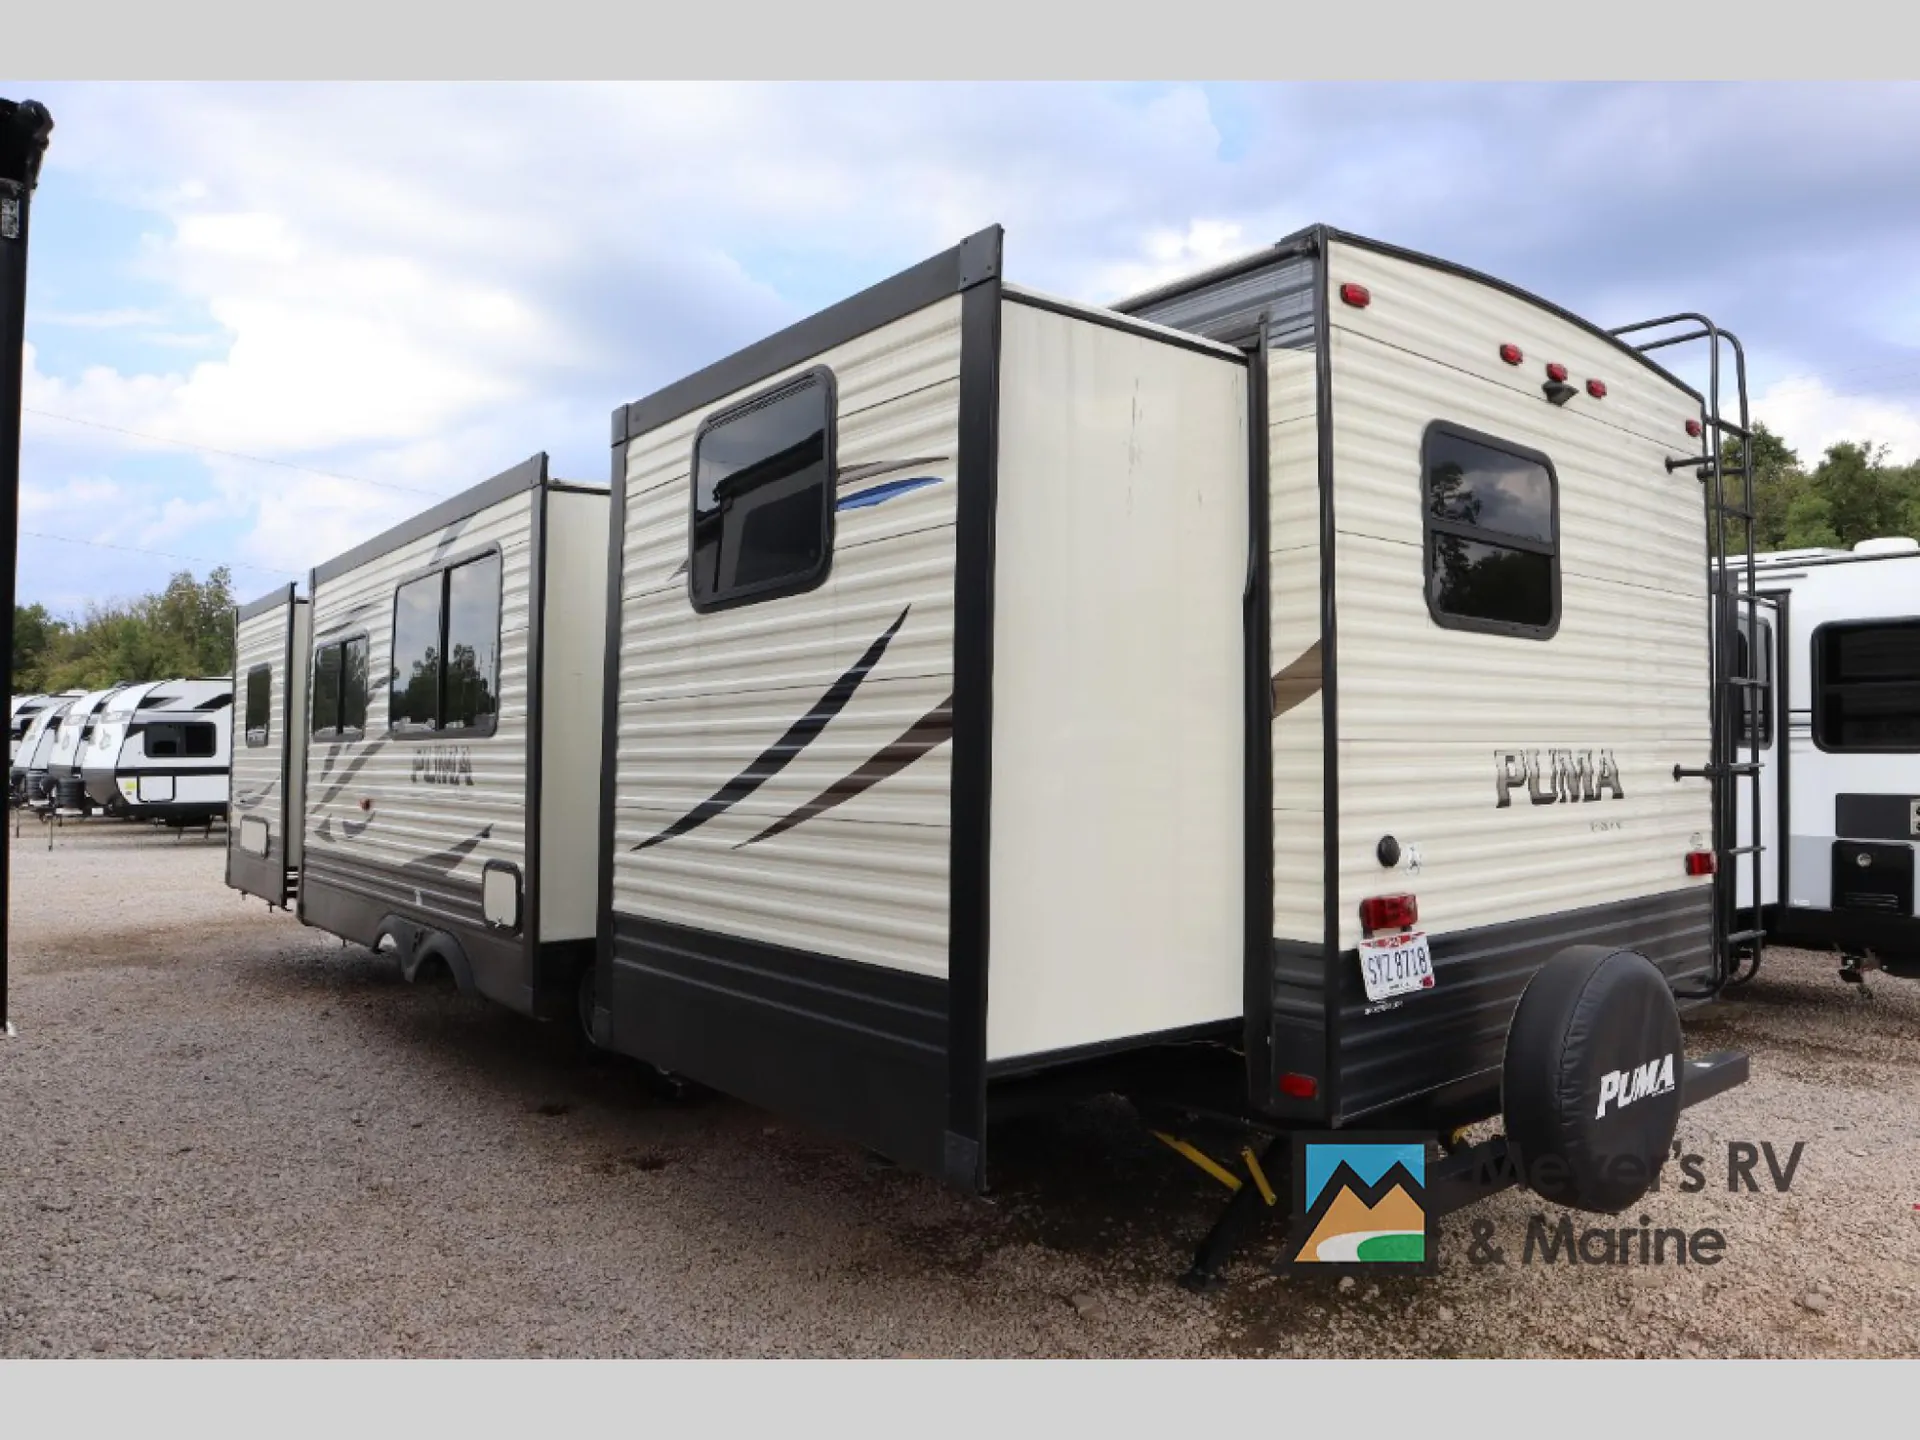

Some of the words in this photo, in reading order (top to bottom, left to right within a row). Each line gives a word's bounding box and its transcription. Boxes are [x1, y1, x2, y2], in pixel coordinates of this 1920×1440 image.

[1494, 748, 1624, 808] PUMA
[1394, 946, 1428, 980] 8718
[1595, 1053, 1675, 1120] PUMA
